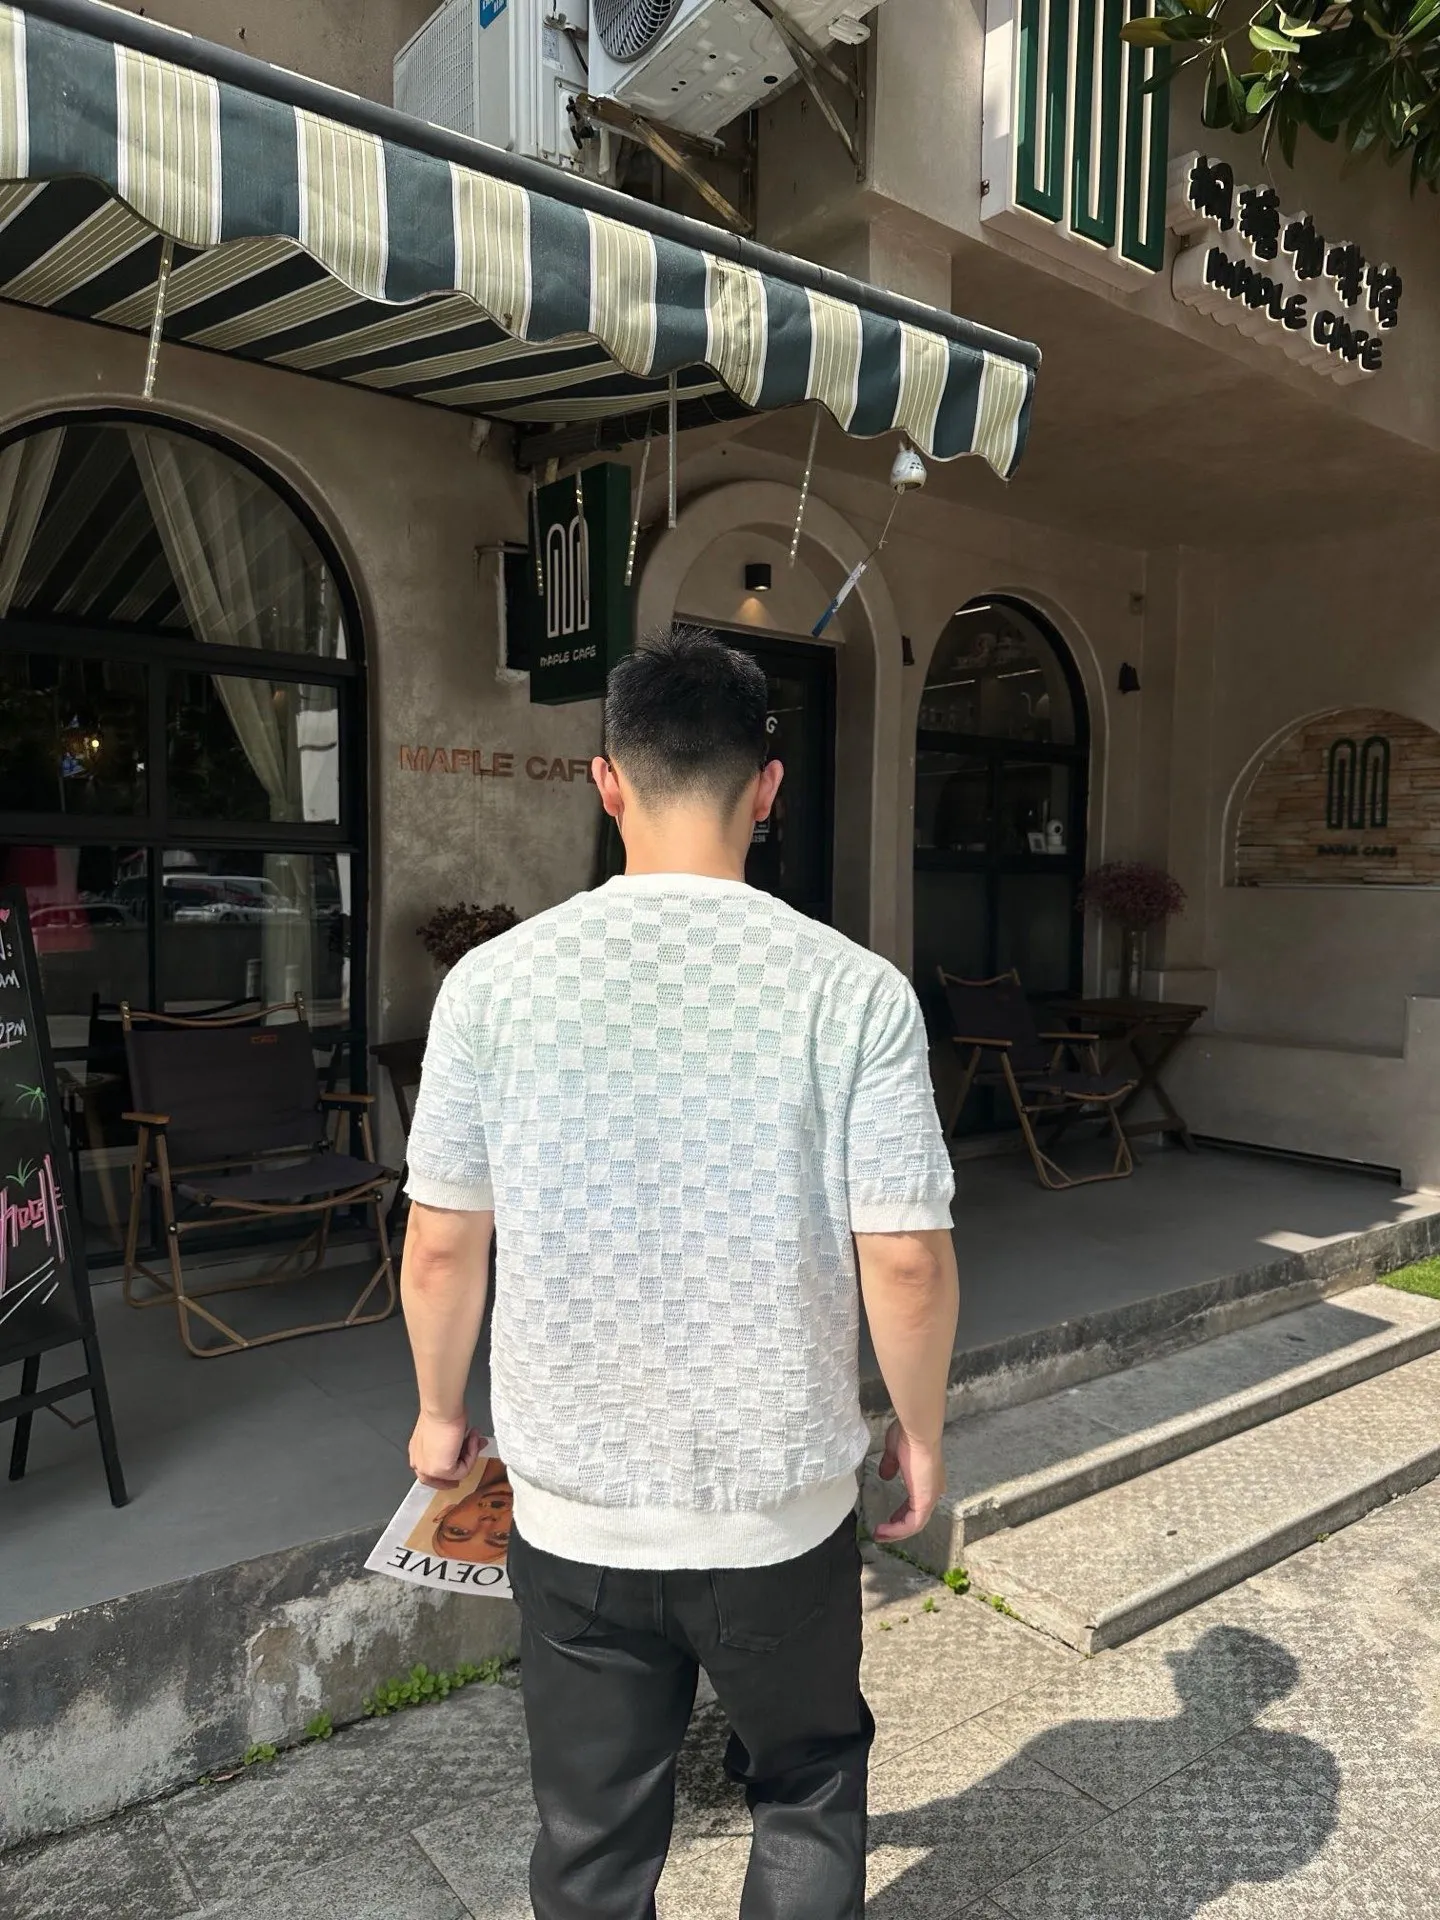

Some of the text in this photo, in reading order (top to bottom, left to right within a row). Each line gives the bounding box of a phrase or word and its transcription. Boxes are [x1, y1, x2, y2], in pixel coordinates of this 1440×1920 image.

[1204, 247, 1383, 371] MAPLE CAFE
[540, 644, 597, 667] MAPLE CAFE
[400, 744, 514, 777] MAPLE
[386, 1546, 512, 1589] OEWE
